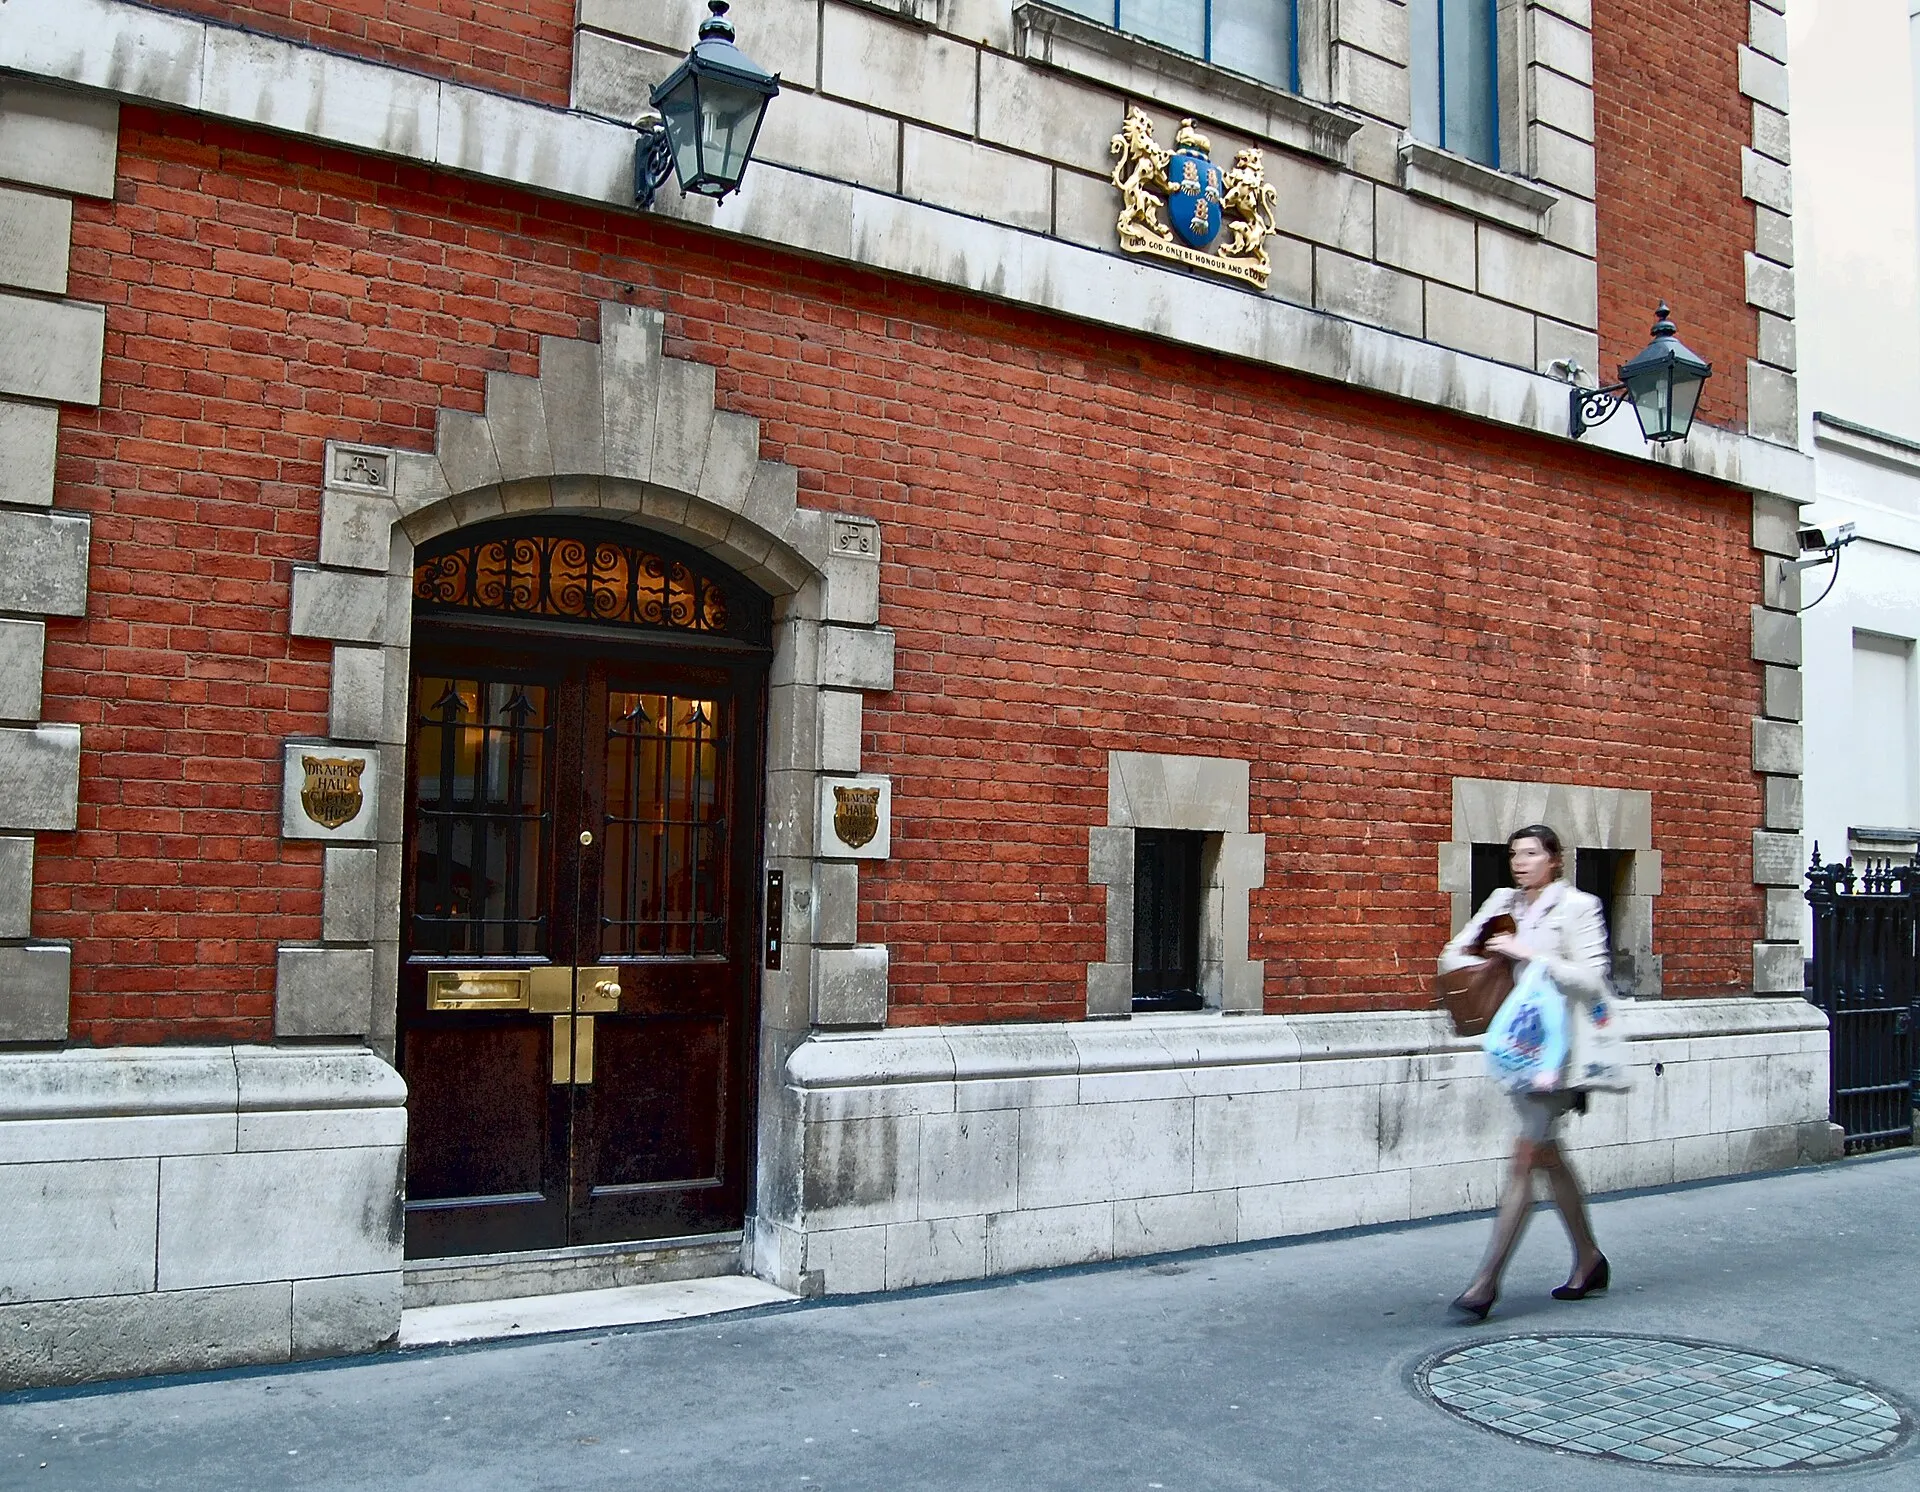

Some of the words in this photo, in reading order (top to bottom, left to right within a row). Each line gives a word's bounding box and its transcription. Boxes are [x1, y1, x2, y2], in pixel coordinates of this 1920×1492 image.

[1149, 241, 1163, 251] GOD
[1166, 246, 1183, 258] ONLY
[1184, 251, 1193, 261] BE
[1195, 254, 1226, 269] HONOUR
[1228, 264, 1243, 274] AND
[1244, 267, 1266, 284] GLORY
[352, 456, 367, 471] A
[848, 525, 860, 538] D
[318, 777, 350, 791] HALL
